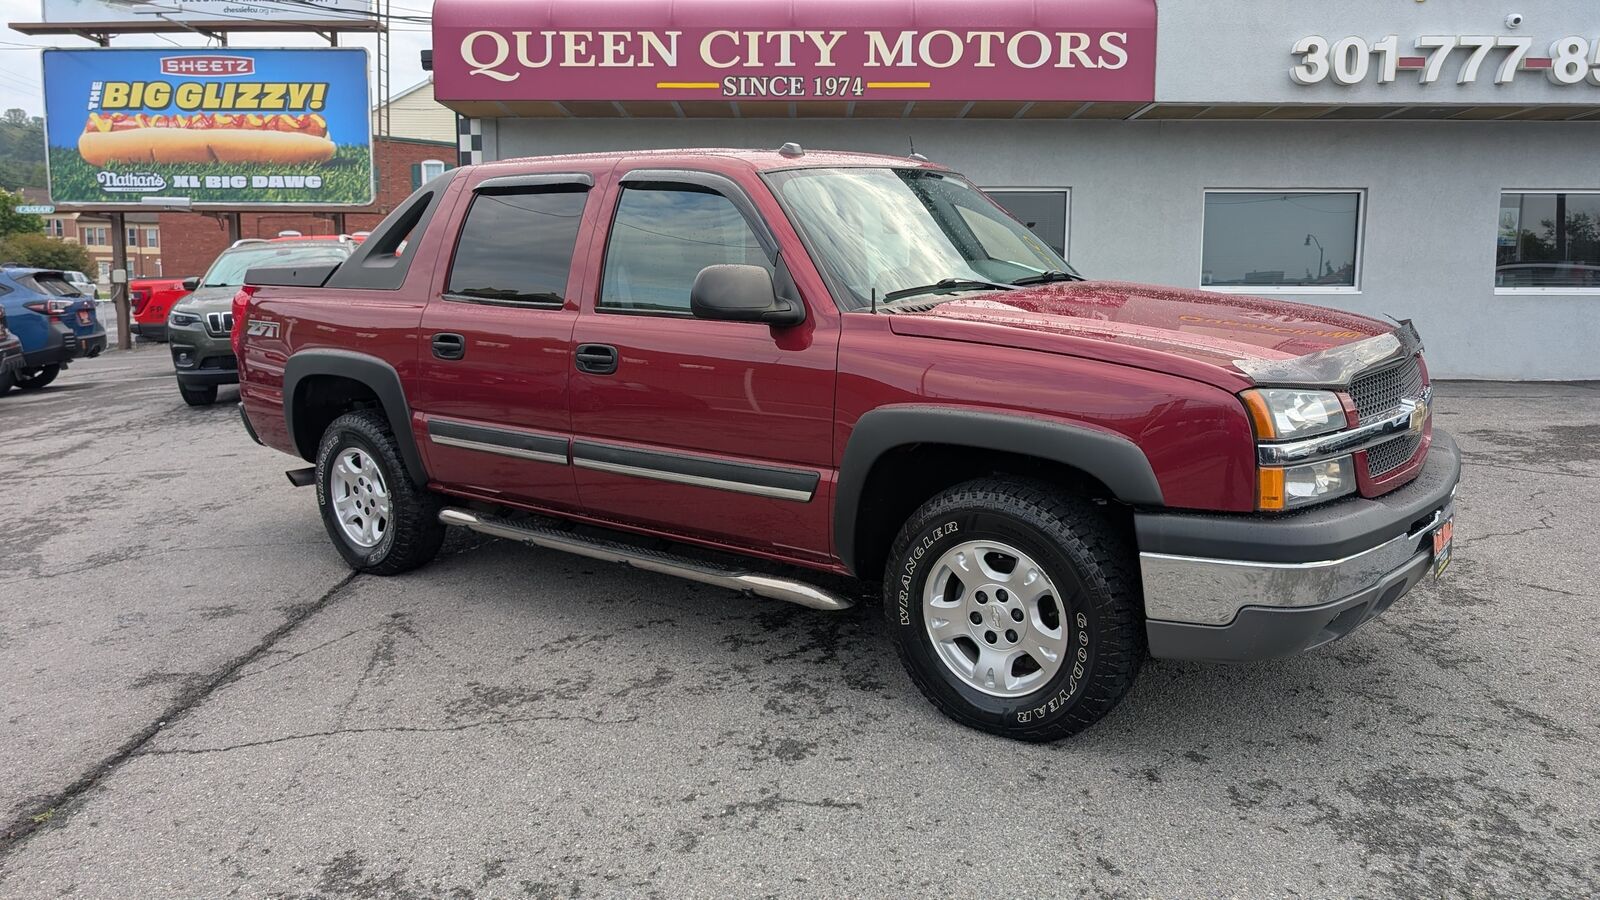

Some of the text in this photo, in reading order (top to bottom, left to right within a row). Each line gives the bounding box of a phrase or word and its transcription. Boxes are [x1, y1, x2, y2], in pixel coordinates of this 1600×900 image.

[166, 60, 249, 72] SHEETZ
[460, 30, 1129, 82] QUEEN CITY MOTORS
[88, 81, 103, 110] THE
[101, 82, 328, 111] BIG GLIZZY!
[722, 76, 864, 97] SINCE 1974
[97, 171, 166, 188] Nathan's
[172, 175, 323, 188] XL BIG DAWG
[247, 320, 280, 338] Z71
[899, 521, 959, 626] WRANGLER
[1017, 612, 1089, 723] GOODYEAR
